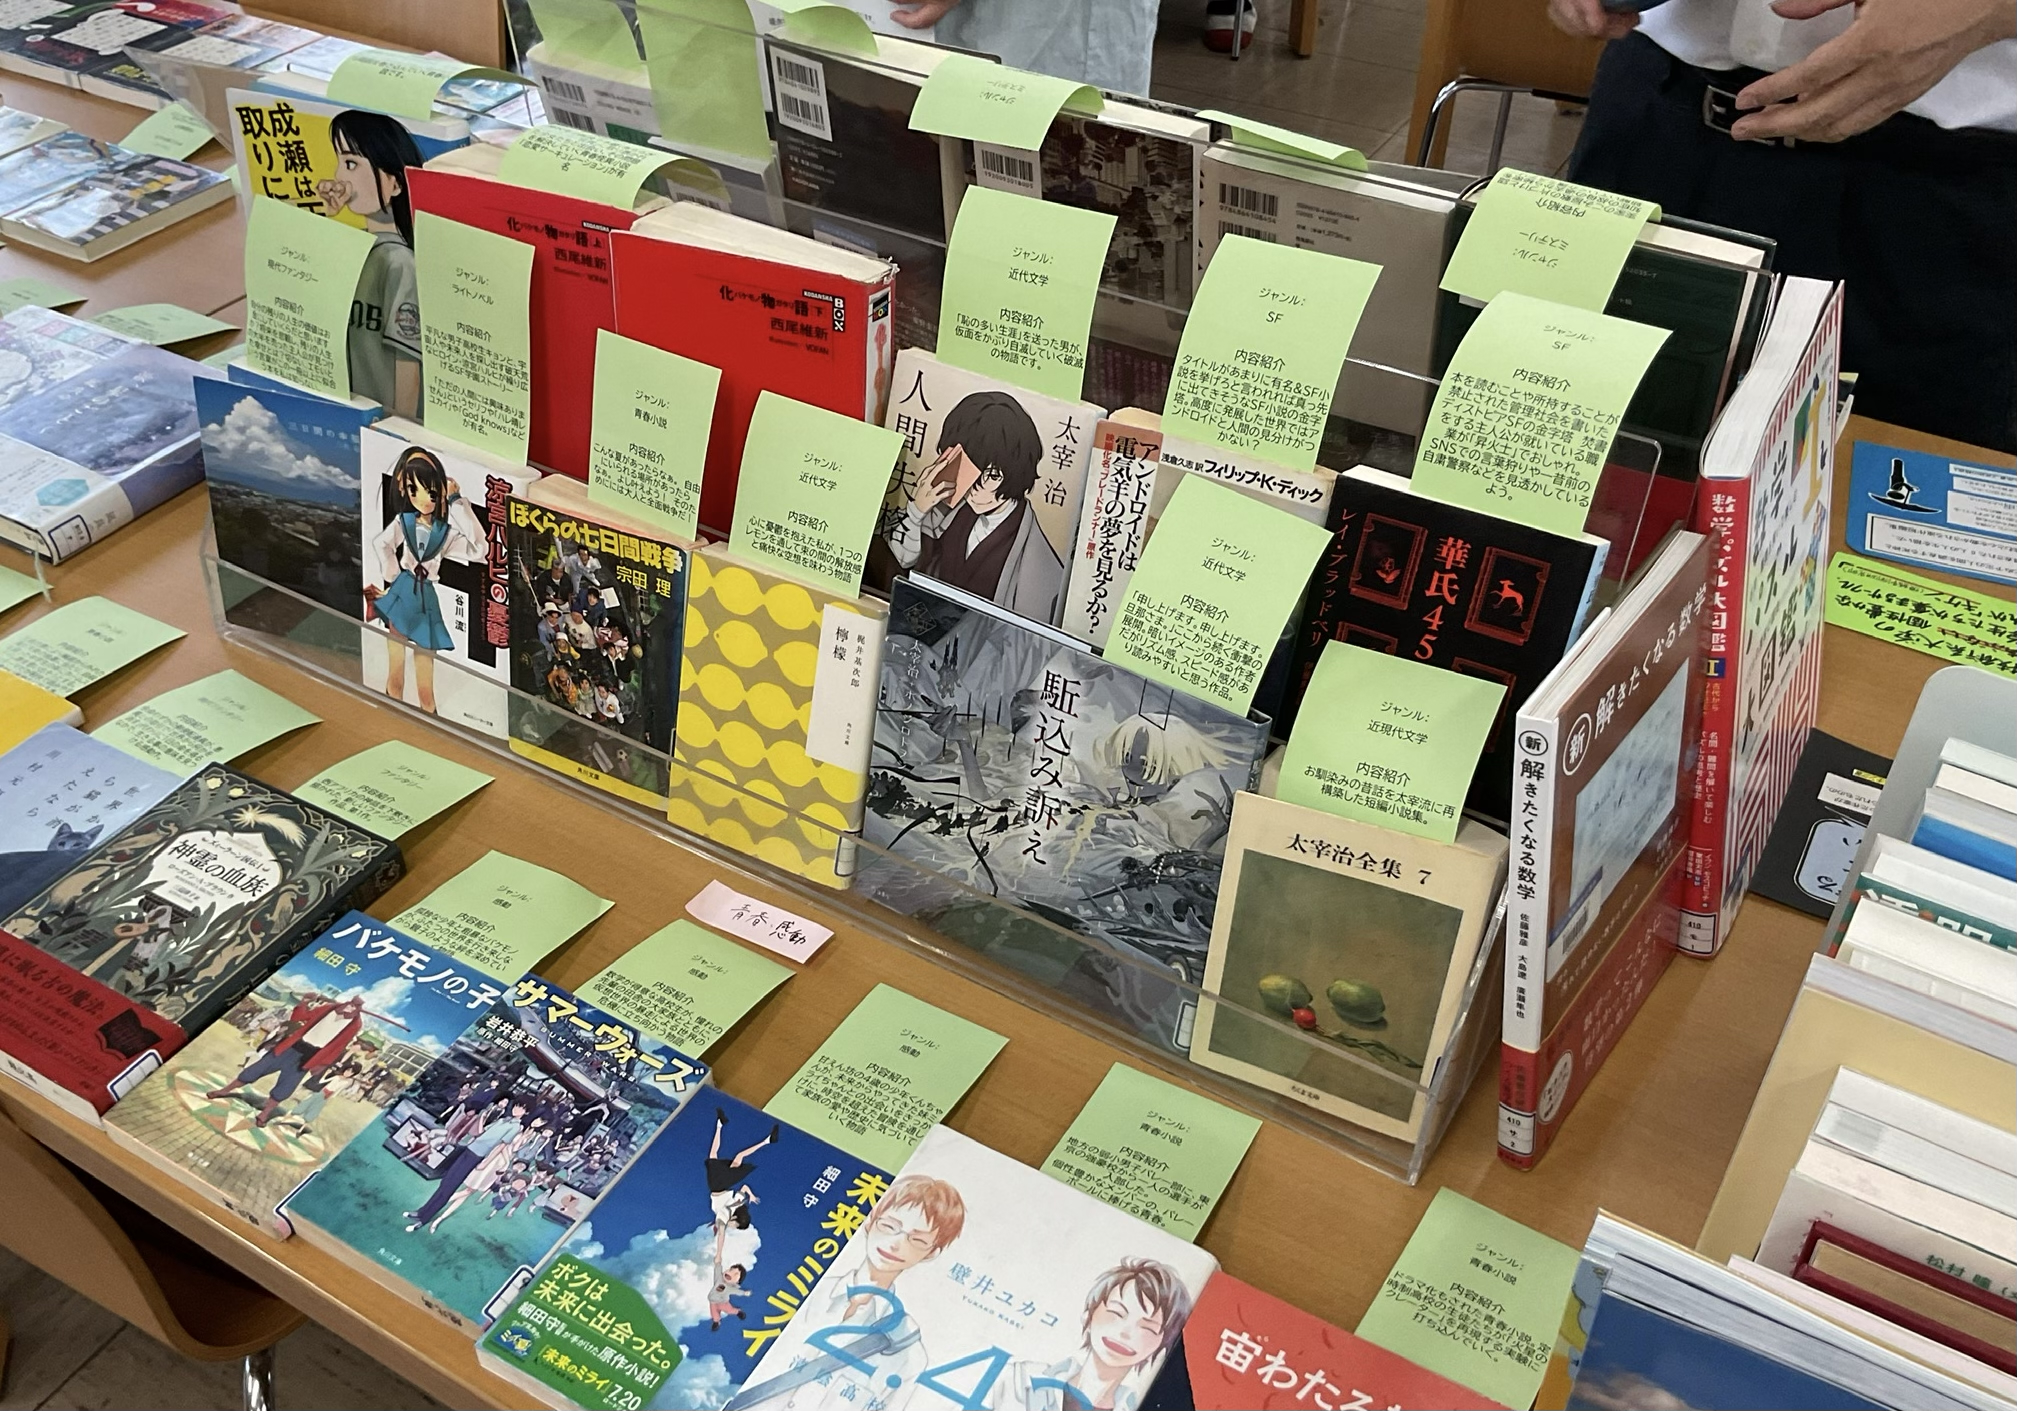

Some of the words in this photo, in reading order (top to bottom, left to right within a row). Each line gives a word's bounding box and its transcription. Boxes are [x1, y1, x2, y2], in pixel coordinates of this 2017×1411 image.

[236, 105, 282, 199] 取りに
[561, 162, 570, 171] 名
[1535, 198, 1587, 218] 内容紹介
[1012, 246, 1054, 265] ジャンル:
[1519, 231, 1569, 251] ミステリー
[554, 248, 607, 271] 西尾維新
[1512, 248, 1559, 269] ジャンル:
[455, 267, 490, 286] ジャンル:
[1008, 267, 1049, 287] 近代文学
[275, 297, 304, 316] 内容紹介
[452, 284, 494, 306] ライトノベル
[1259, 288, 1307, 306] ジャンル:
[457, 322, 491, 342] 内容紹介
[770, 317, 828, 340] 西尾維新
[999, 307, 1044, 330] 内容紹介
[1266, 311, 1284, 324] SF
[955, 326, 1084, 370] 仮面をかぶり自滅していく破滅
[957, 313, 1083, 357] 「恥の多い生涯」を送った男が、
[1544, 324, 1596, 343] ジャンル:
[1552, 341, 1571, 351] SF
[990, 348, 1042, 370] の物語です。
[1234, 349, 1286, 372] 内容紹介
[1177, 366, 1328, 416] 説を挙げろと言われれば真っ先
[1512, 367, 1572, 392] 内容紹介
[635, 389, 670, 409] ジャンル:
[1177, 380, 1322, 426] に出てきそうなSF小説の金字
[1447, 386, 1610, 438] 禁止された管理社会を書いた
[1450, 372, 1619, 425] 本を読むことや所持することが
[463, 419, 488, 436] が有名。
[634, 408, 668, 430] 青春小説
[1171, 404, 1316, 452] ンドロイドと人間の見分けがつ
[1173, 392, 1320, 438] 塔。高度に発展した世界ではア
[1216, 431, 1261, 451] かない？
[1440, 411, 1600, 467] をする主人公が就いている職
[1443, 427, 1582, 477] 業が「昇火士」でおしゃれ。
[629, 443, 665, 466] 内容紹介
[804, 452, 842, 472] ジャンル:
[1043, 415, 1081, 508] 太宰治
[1429, 437, 1591, 493] SNSでの言葉狩りや一昔前の
[601, 457, 690, 501] にいられる場所があったら
[799, 471, 838, 491] 近代文学
[1422, 450, 1590, 508] 自粛警察などを見透かしている
[1484, 485, 1514, 501] よう。
[1118, 435, 1159, 572] アンドロイドは
[787, 510, 829, 533] 内容紹介
[1085, 435, 1138, 635] 電気羊の夢を見るか?
[510, 501, 684, 575] ぼくらの七日間戦争
[745, 525, 861, 575] レモンを通して束の間の解放感
[1211, 537, 1257, 563] ジャンル:
[751, 540, 852, 583] と痛快な空想を味わう物語
[1201, 556, 1247, 582] 近代文学
[616, 565, 648, 590] 宗田
[655, 576, 672, 599] 理
[1310, 507, 1358, 647] レイ・ブラッドベリ
[454, 594, 464, 618] 谷川
[1180, 594, 1230, 624] 内容紹介
[1123, 602, 1264, 672] 旦那さま。」ここから続く衝撃の
[1131, 589, 1264, 658] 「申し上げます。申し上げます。
[832, 625, 850, 662] 檸檬
[1121, 614, 1258, 684] 展開。暗いイメージのある作者
[850, 634, 866, 688] 梶井基次郎
[1119, 626, 1250, 694] だがリズム感、スピード感があ
[1123, 642, 1234, 702] り読みやすいと思う作品。
[1380, 700, 1431, 725] ジャンル:
[1366, 719, 1430, 745] 近現代文学
[1524, 735, 1543, 751] 新
[1021, 669, 1084, 866] 駈込み訴え
[1355, 760, 1412, 789] 内容紹介
[358, 784, 396, 803] 内容紹介
[1304, 764, 1457, 820] お馴染みの昔話を太宰流に再
[1320, 782, 1430, 826] 構築した短編小説集。
[1515, 758, 1546, 902] 解きたくなる数学
[168, 840, 269, 897] 神霊の血族
[1285, 832, 1403, 880] 太宰治全集
[1417, 869, 1433, 885] 7
[492, 898, 512, 909] 感動
[456, 912, 496, 933] 内容紹介
[313, 947, 343, 969] 細田
[345, 961, 362, 976] 守
[332, 921, 501, 1011] バケモノの子
[688, 968, 709, 981] 感動
[652, 981, 695, 1004] 内容紹介
[486, 1016, 539, 1048] 岩井恭平
[513, 978, 705, 1093] サマーウォーズ
[597, 996, 686, 1047] 危機に立ち向かう物語
[540, 1026, 592, 1058] SUMMER
[899, 1044, 921, 1058] 感動
[900, 1028, 941, 1050] ジャンル:
[818, 1055, 943, 1116] 甘えん坊の4歳の少年くんちゃ
[866, 1062, 912, 1087] 内容紹介
[797, 1077, 925, 1139] けに、時空を超えた冒険を通し
[807, 1071, 932, 1130] ライちゃんとの出会いをきっか
[811, 1063, 938, 1123] んが、未来からやってきた妹ミ
[795, 1085, 918, 1147] て家族の愛や歴史に気づいて
[828, 1112, 867, 1136] いく物語
[1146, 1110, 1191, 1133] ジャンル:
[1507, 1114, 1521, 1128] 410
[1139, 1122, 1183, 1147] 青春小説
[1119, 1145, 1170, 1172] 内容紹介
[812, 1165, 842, 1195] 細田
[1052, 1158, 1195, 1227] 個性豊かなメンバーの、バレー
[1063, 1145, 1203, 1211] 京の強豪校から一人の選手が
[1105, 1171, 1150, 1198] 入部した。
[803, 1193, 819, 1209] 守
[1064, 1176, 1166, 1228] ボールに捧げる青春。
[742, 1171, 889, 1358] 未来のミライ
[1468, 1256, 1518, 1286] 青春小説
[1475, 1242, 1526, 1271] ジャンル:
[551, 1261, 610, 1302] ボクは
[947, 1262, 1058, 1327] 壁井ユカコ
[1449, 1282, 1507, 1315] 内容紹介
[532, 1280, 672, 1370] 未来に出会った。
[1412, 1312, 1499, 1363] 打ち込んでいく。
